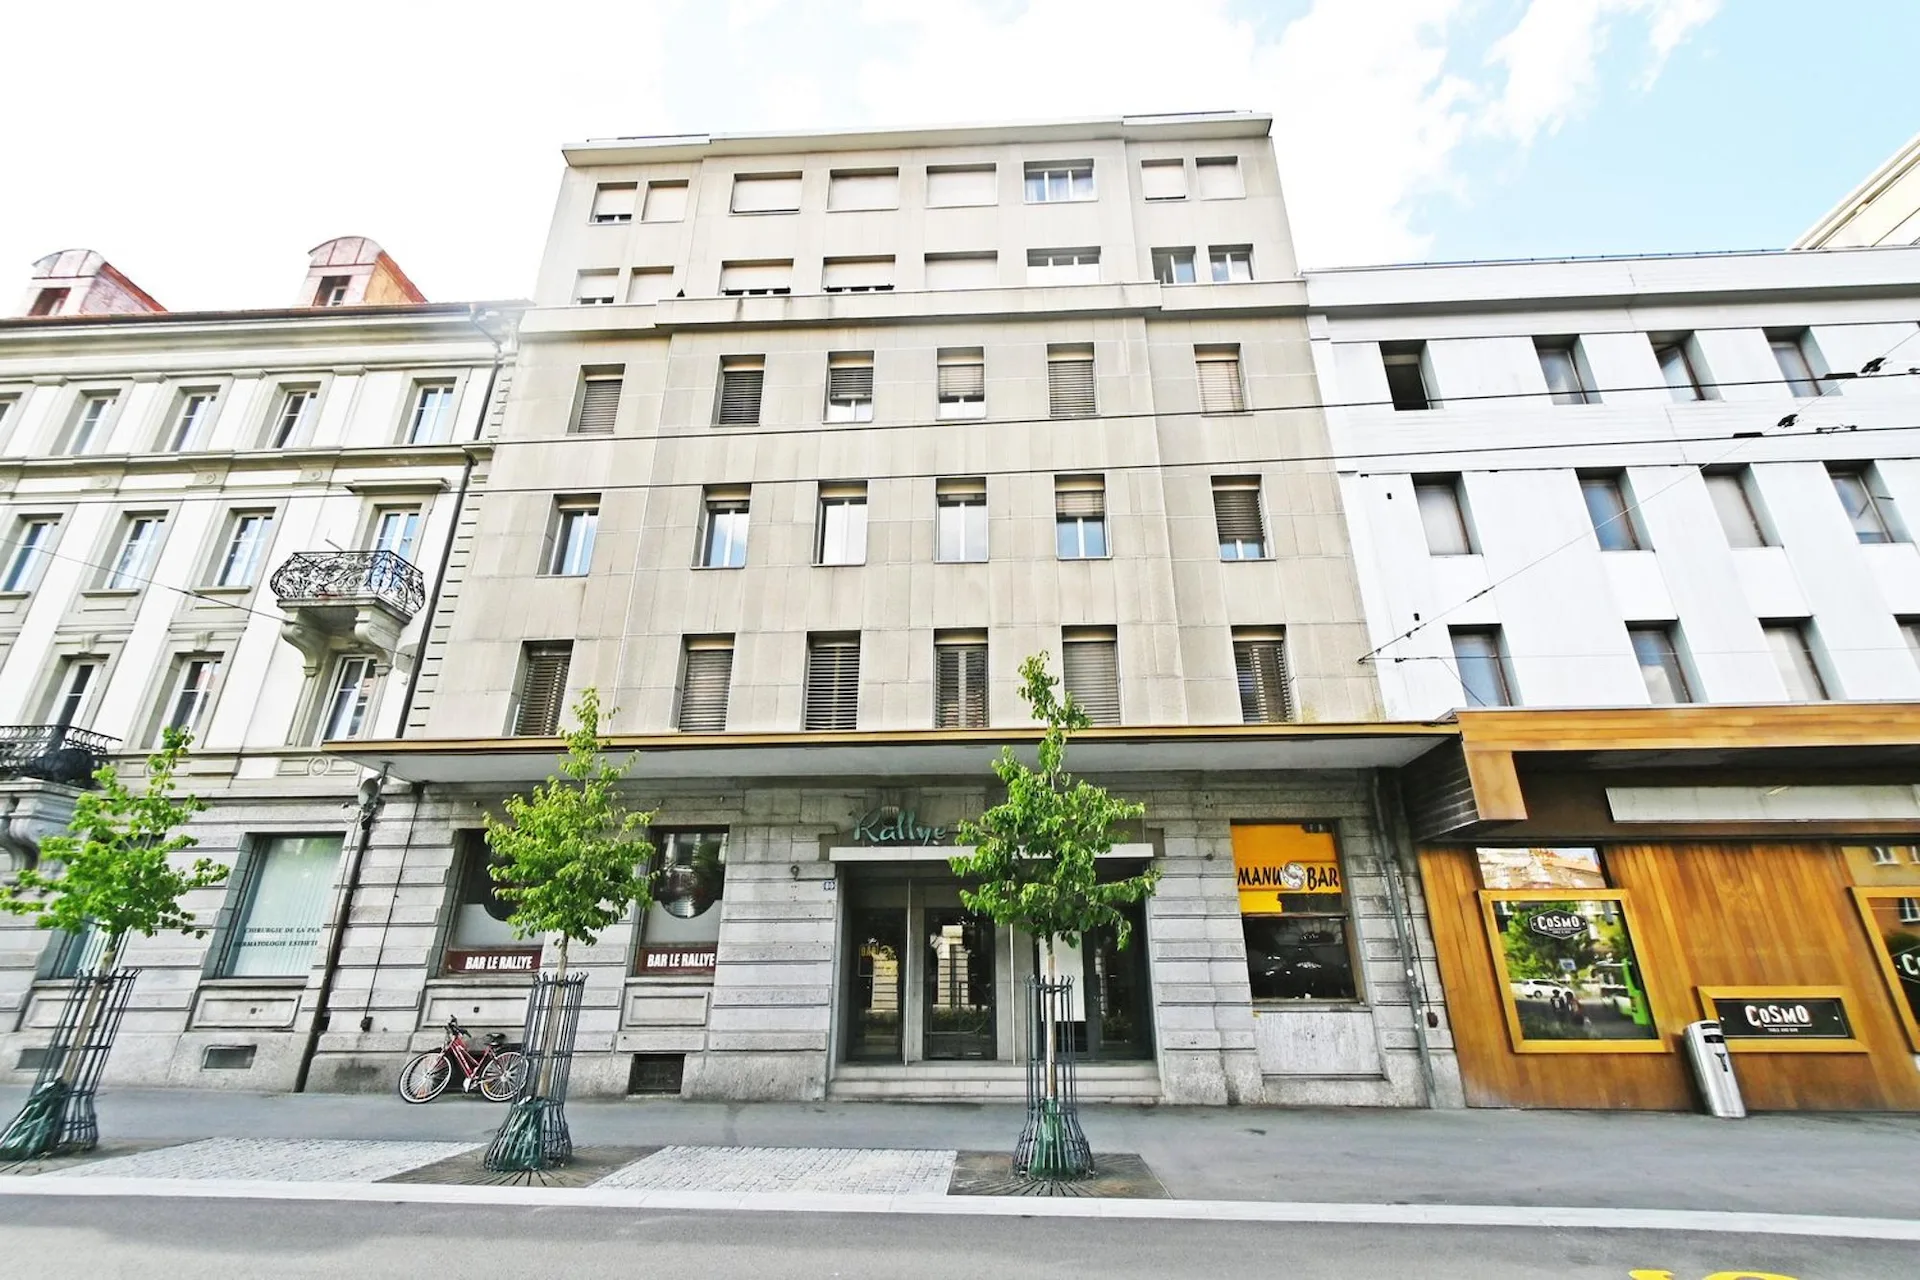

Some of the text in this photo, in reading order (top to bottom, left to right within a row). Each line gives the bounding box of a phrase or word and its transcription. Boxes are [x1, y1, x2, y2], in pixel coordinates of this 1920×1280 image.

[1306, 866, 1339, 891] BAR
[1537, 915, 1580, 930] COSMO
[465, 955, 533, 970] BAR LE RALLYE
[647, 952, 715, 967] BAR LE RALLYE
[1901, 953, 1920, 975] C
[1744, 1004, 1810, 1027] COSMO
